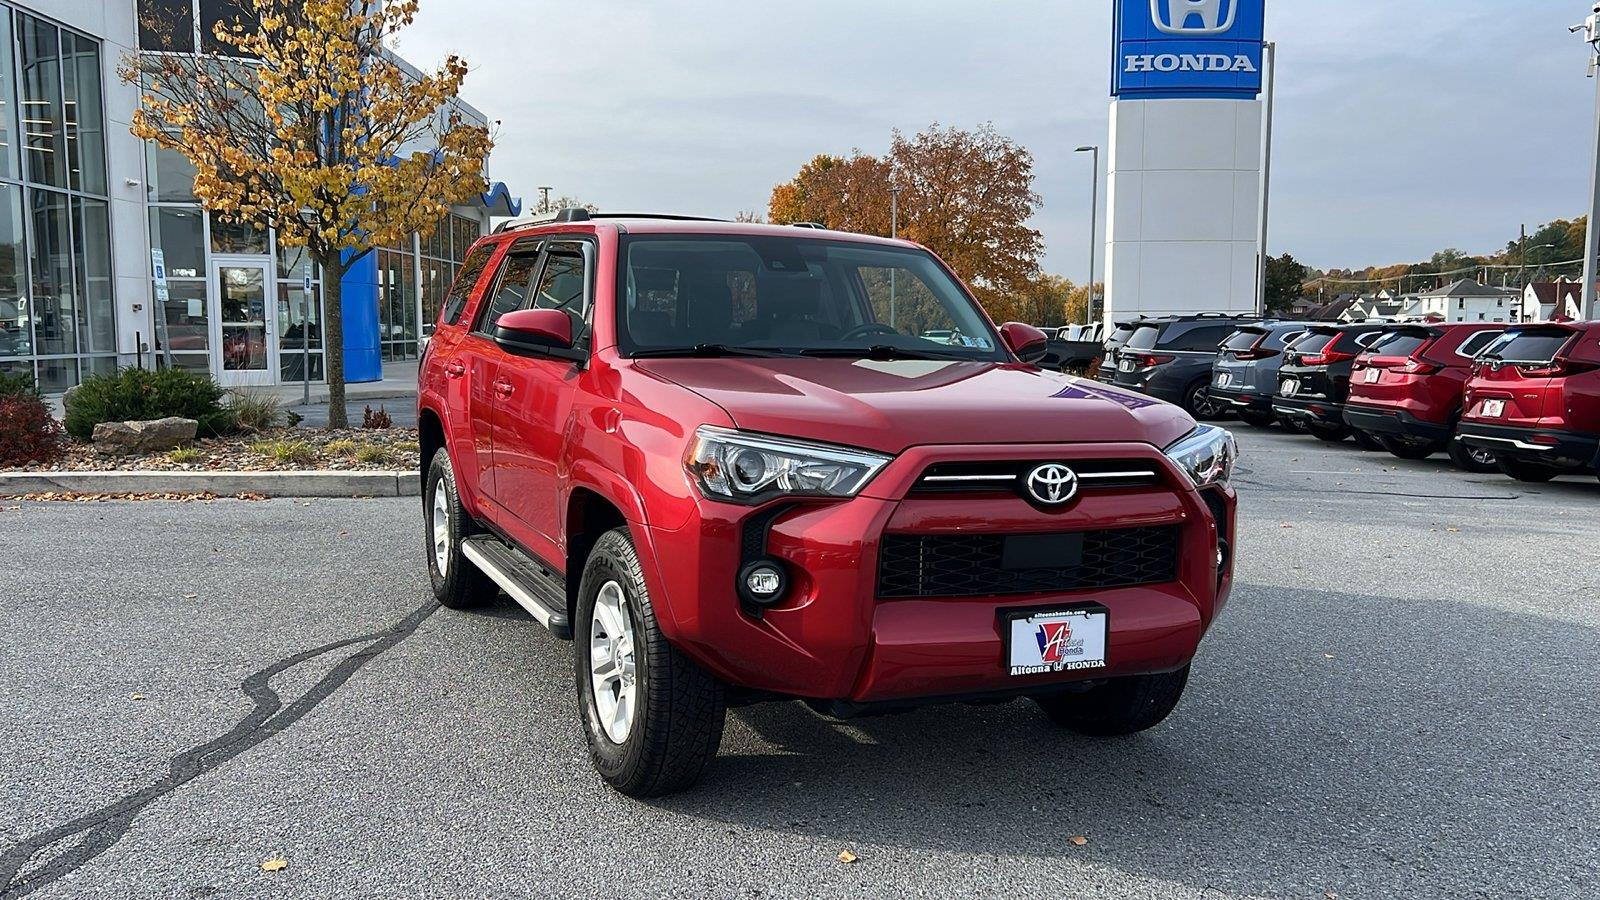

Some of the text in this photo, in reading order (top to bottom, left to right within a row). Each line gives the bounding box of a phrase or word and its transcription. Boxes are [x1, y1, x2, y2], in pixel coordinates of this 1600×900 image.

[1125, 54, 1257, 72] HONDA
[1011, 660, 1106, 676] Altoona HONDA
